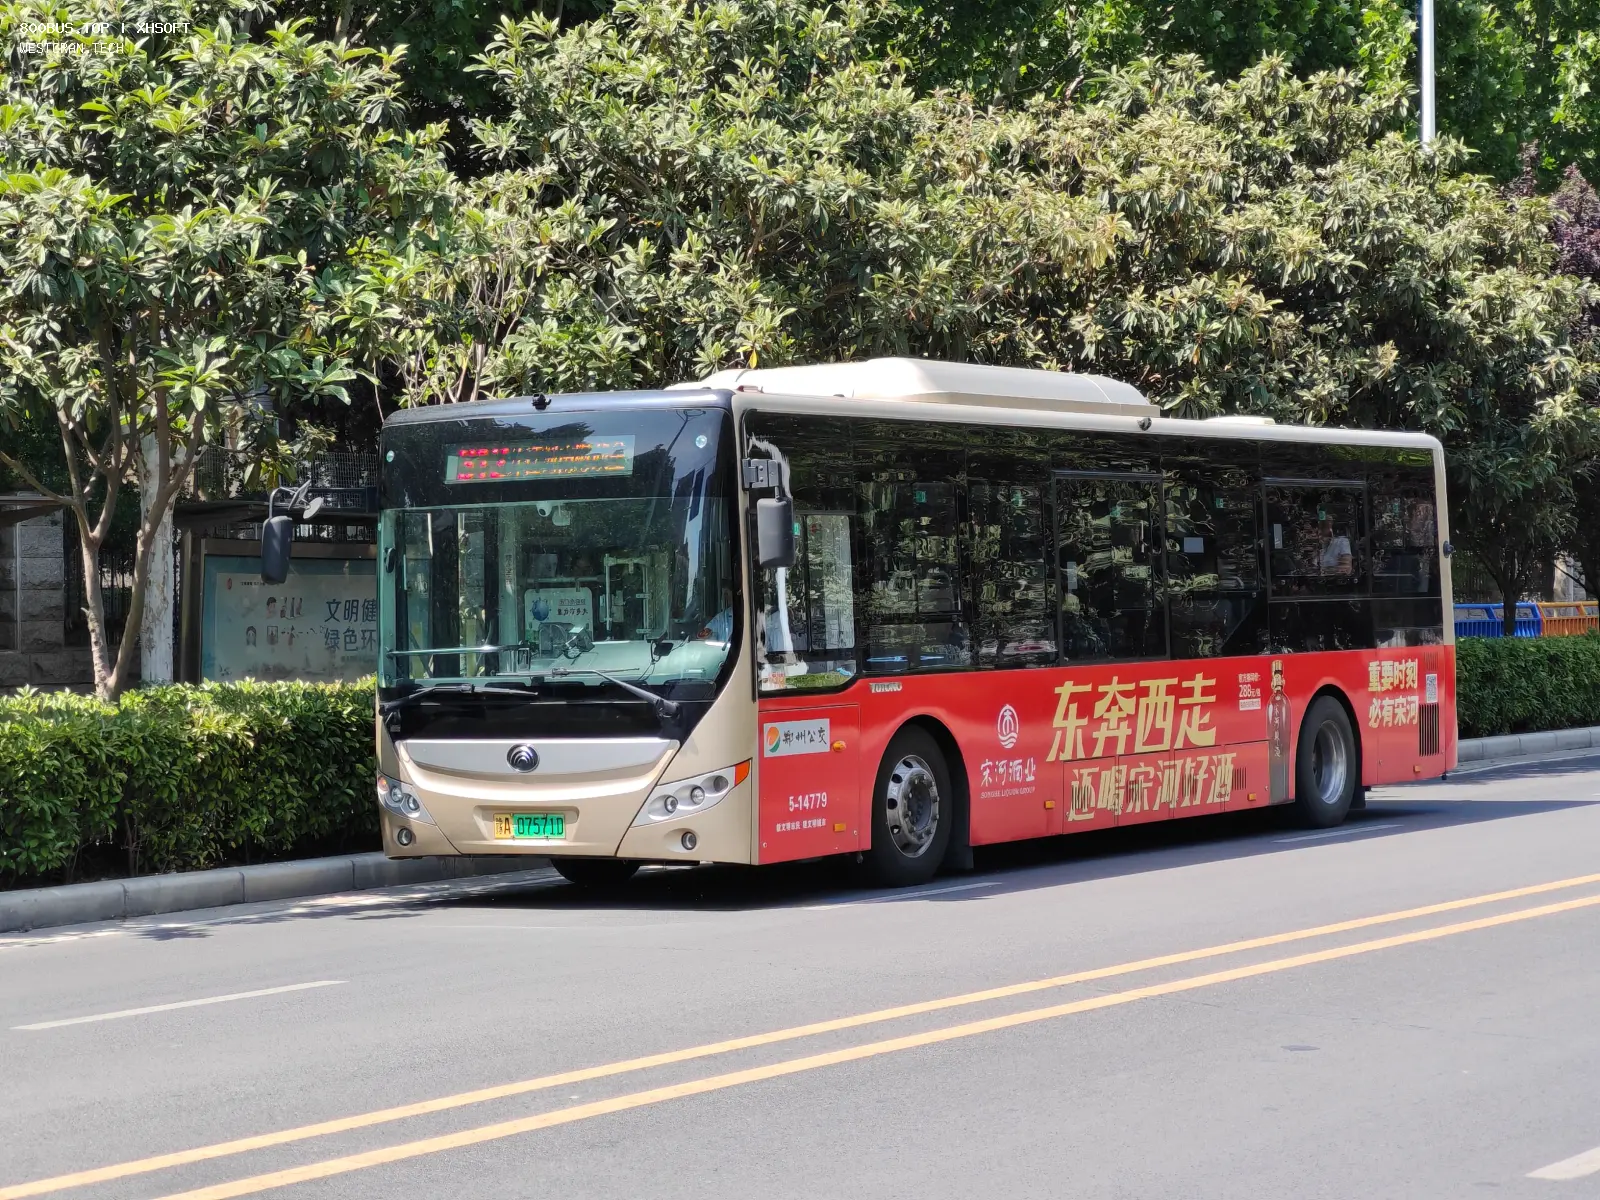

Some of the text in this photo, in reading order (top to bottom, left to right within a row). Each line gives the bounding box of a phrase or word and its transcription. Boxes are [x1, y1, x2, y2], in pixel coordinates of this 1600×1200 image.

[324, 598, 377, 623] 文明健
[323, 627, 377, 652] 绿色环
[1368, 658, 1419, 692] 重要时刻
[1046, 672, 1217, 761] 东奔西走
[1368, 696, 1420, 728] 必有宋河
[782, 727, 827, 747] 郑州公交
[789, 792, 828, 812] 5-14779
